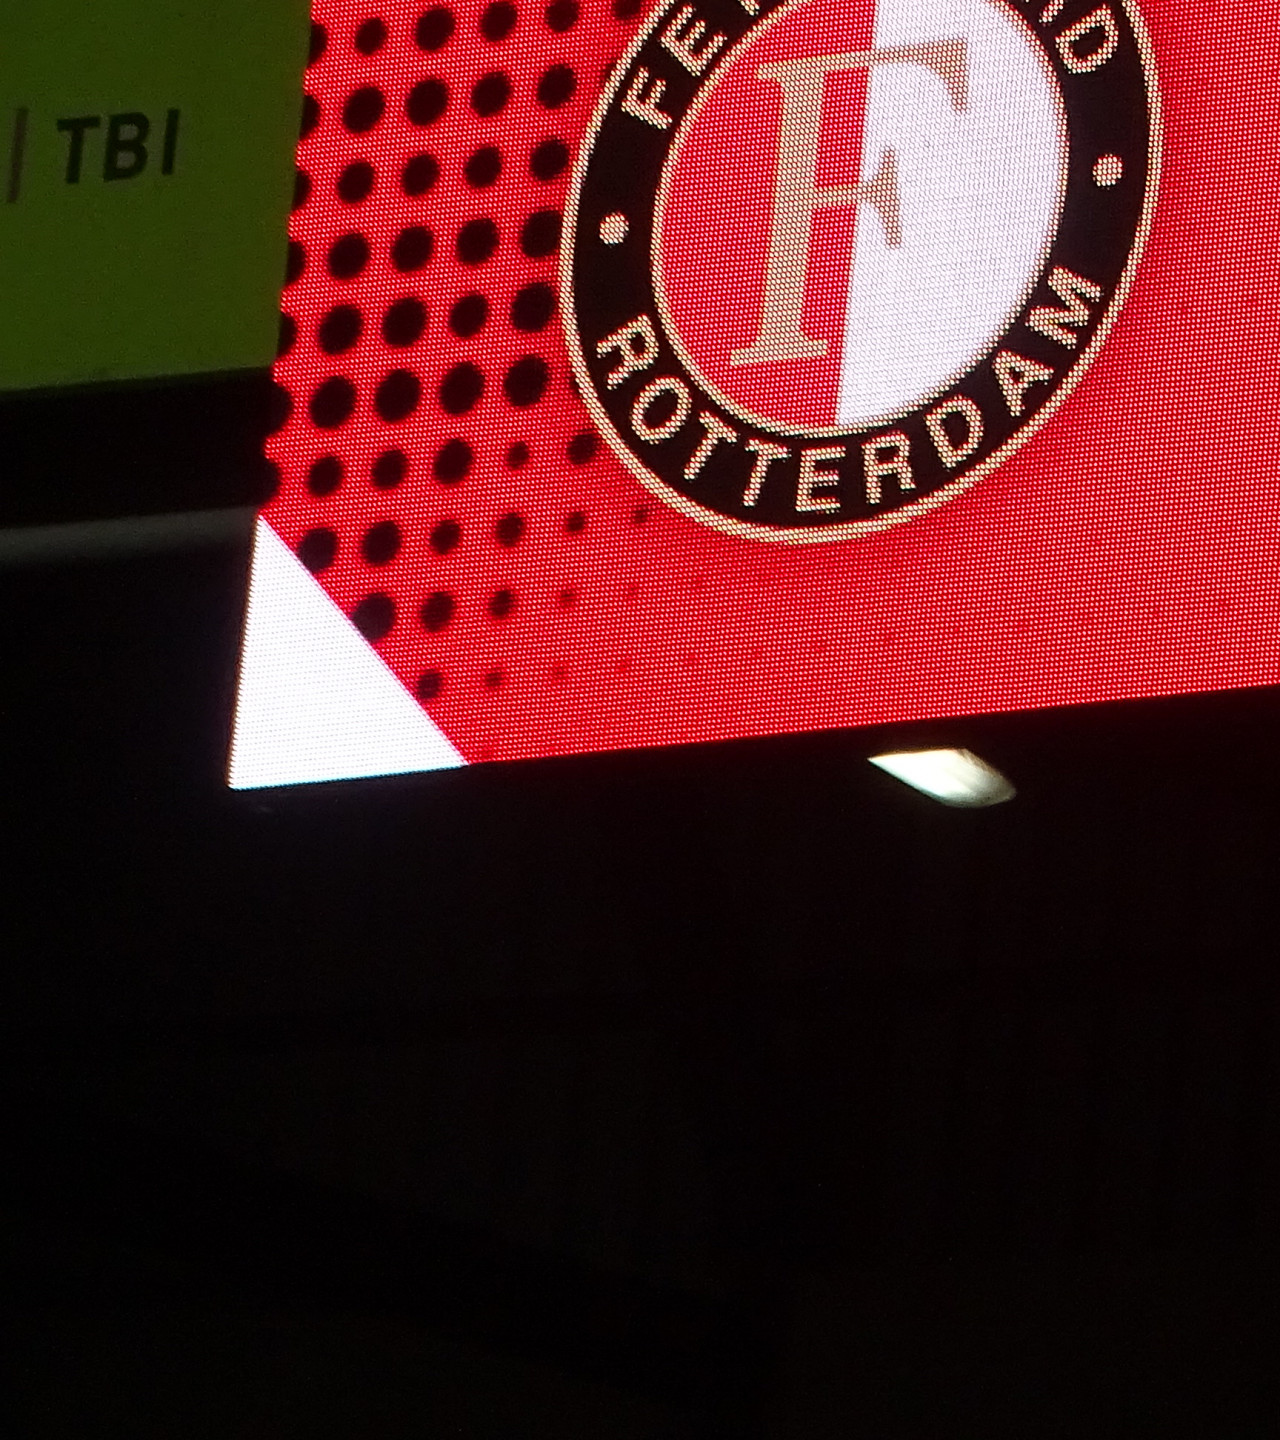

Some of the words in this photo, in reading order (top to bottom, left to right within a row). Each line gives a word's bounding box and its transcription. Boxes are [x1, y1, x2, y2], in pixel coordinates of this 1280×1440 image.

[56, 109, 180, 185] TBI
[730, 38, 968, 366] F
[596, 264, 1102, 513] ROTTERDAM
